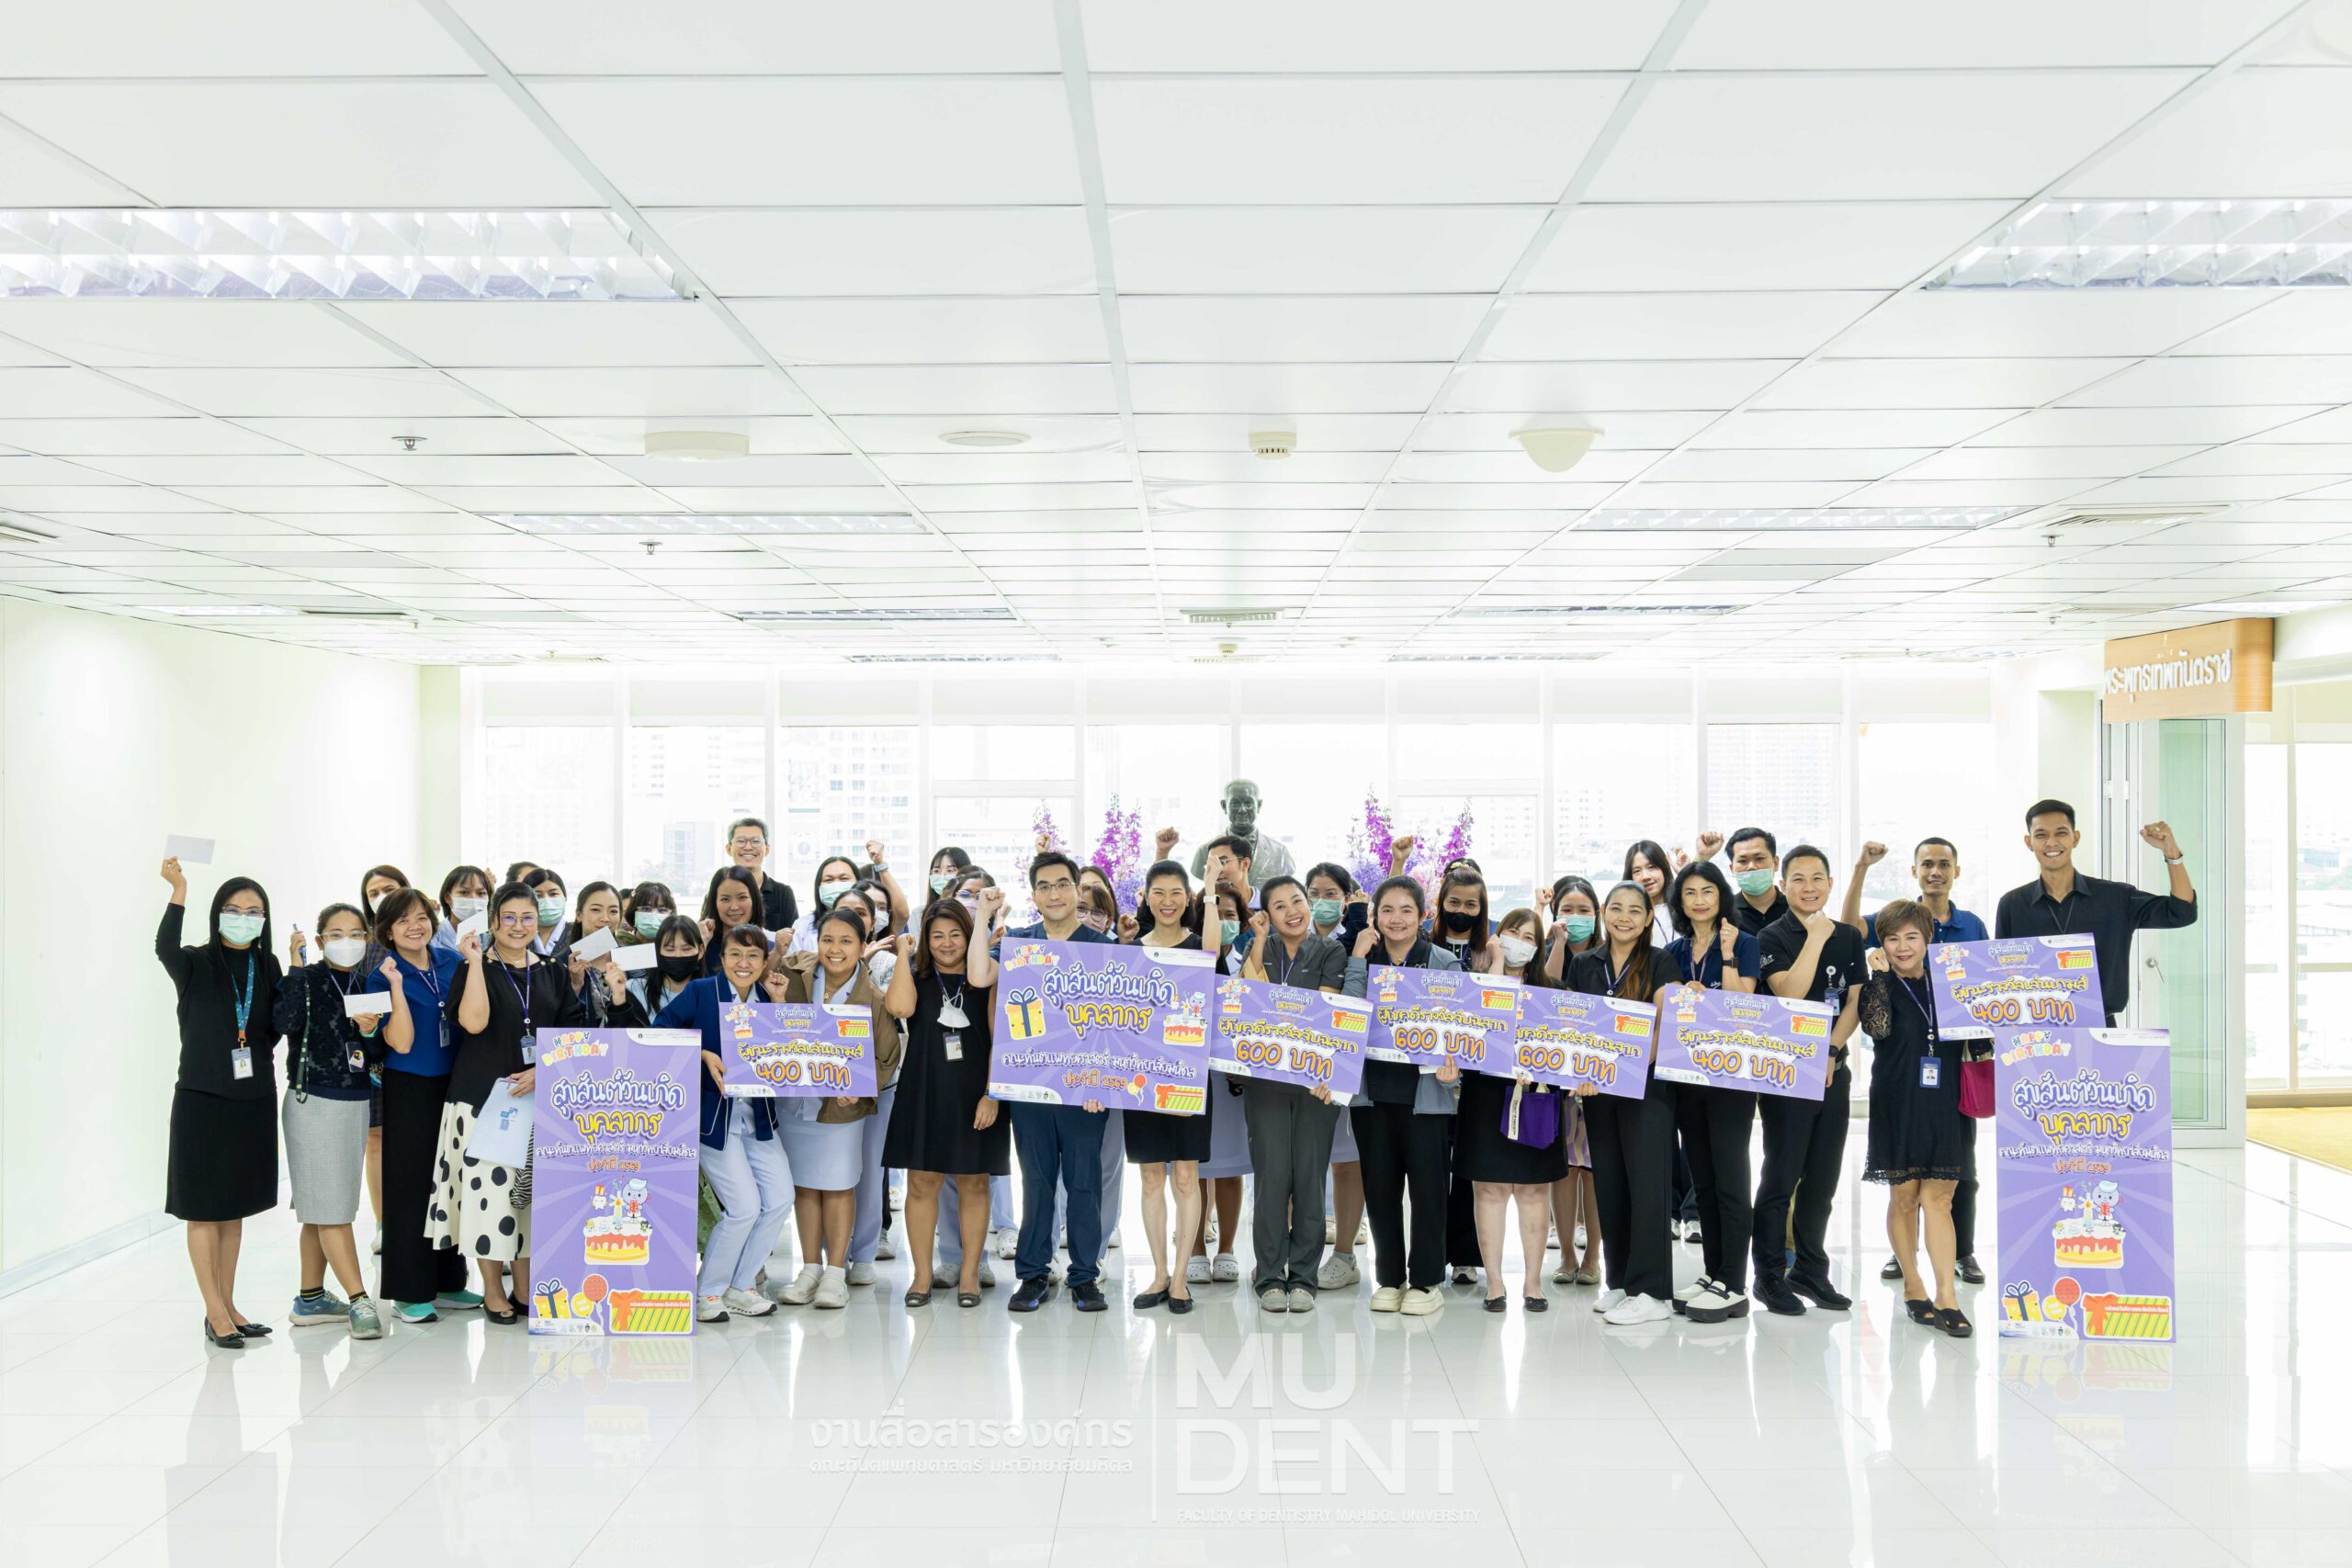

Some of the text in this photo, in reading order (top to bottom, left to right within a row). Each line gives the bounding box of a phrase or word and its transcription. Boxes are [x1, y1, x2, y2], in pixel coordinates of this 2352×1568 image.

[1004, 952, 1060, 971] BIRTHDAY
[1014, 944, 1046, 955] HAPPY
[1044, 961, 1175, 1005] สุขสันต์วันเกิด
[1067, 1002, 1152, 1036] บุคลากร
[1972, 998, 2075, 1024] 400 บาท
[542, 1040, 608, 1066] BIRTHDAY
[554, 1032, 590, 1046] HAPPY
[1396, 1028, 1485, 1061] 600 บาท
[2000, 1039, 2071, 1066] BIRTHDAY
[2012, 1030, 2051, 1047] HAPPY
[756, 1060, 850, 1089] 400 บาท
[1237, 1040, 1332, 1080] 600 บาท
[1519, 1046, 1616, 1085] 600 บาท
[1693, 1049, 1795, 1087] 400 บาท
[552, 1068, 684, 1116] สุขสันต์วันเกิด
[1102, 1076, 1127, 1089] 2569
[2014, 1069, 2154, 1115] สุขสันต์วันเกิด
[576, 1111, 662, 1144] บุคลากร
[2040, 1111, 2132, 1145] บุคลากร
